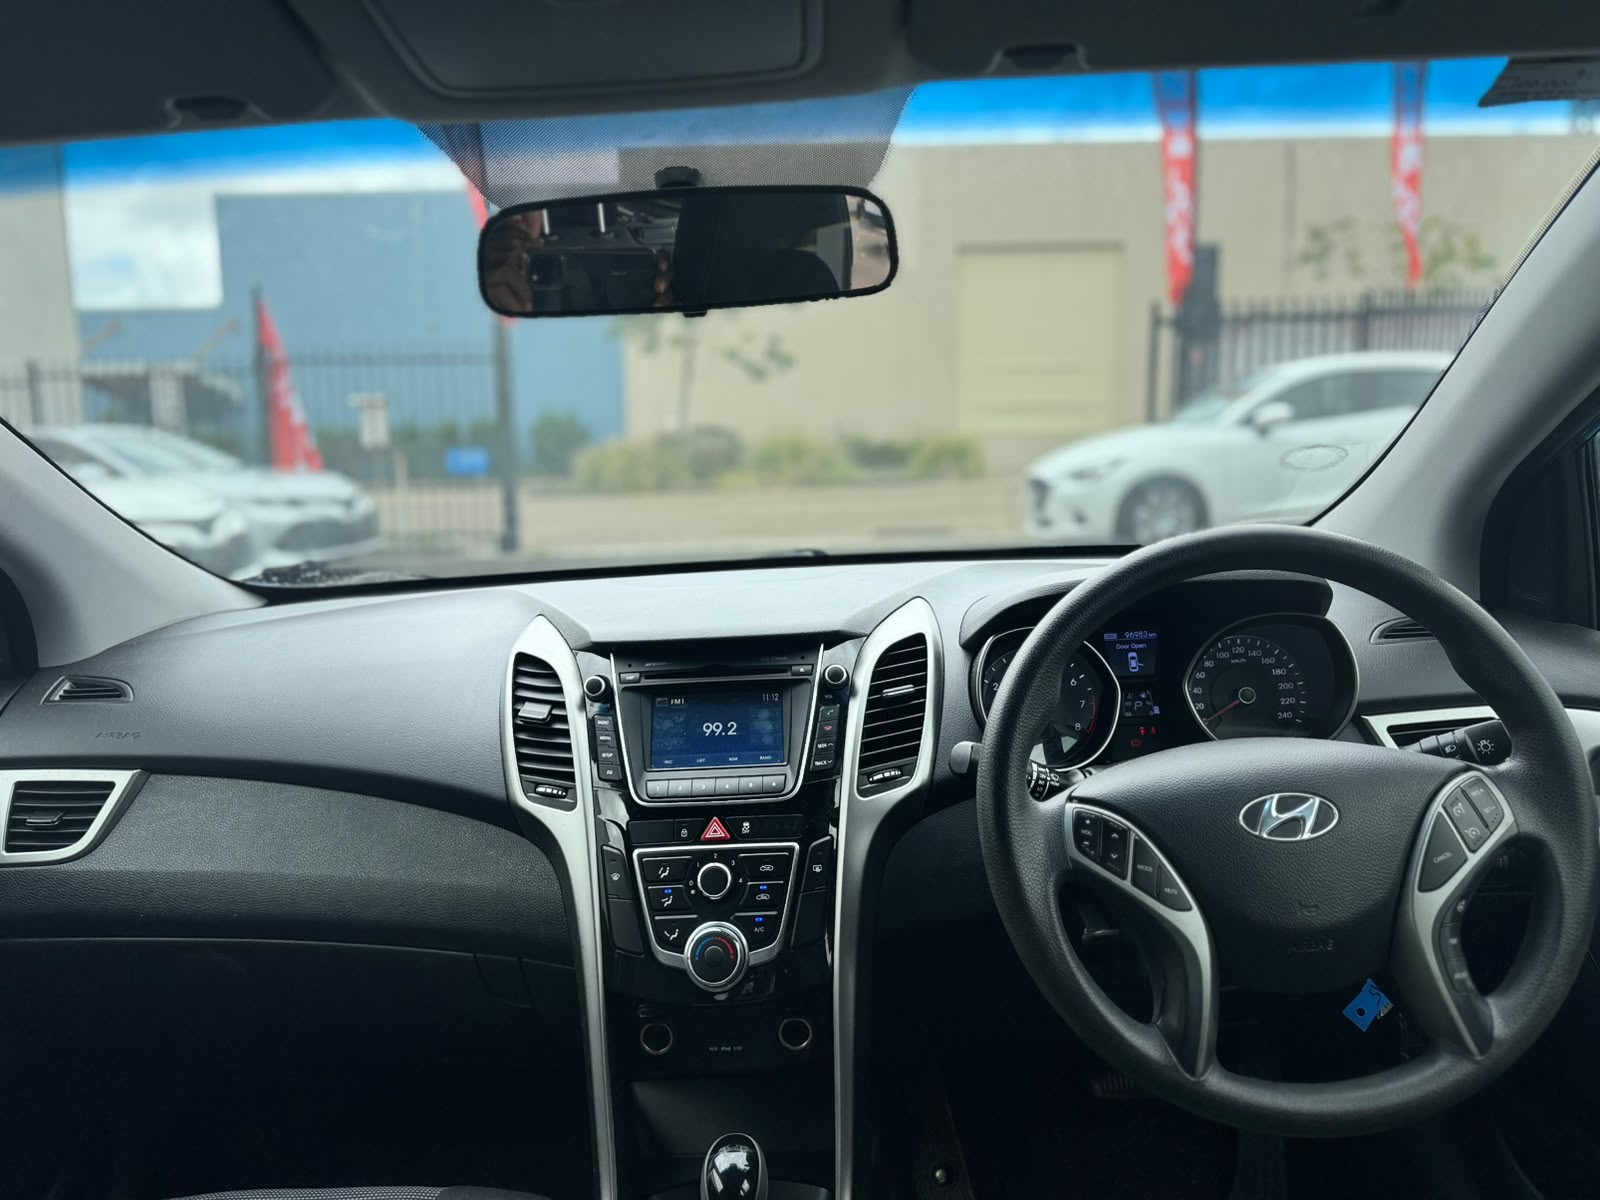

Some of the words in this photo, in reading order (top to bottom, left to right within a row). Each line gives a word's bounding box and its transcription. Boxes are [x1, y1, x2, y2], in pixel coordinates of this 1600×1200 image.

[1216, 651, 1229, 659] 100
[1247, 649, 1262, 657] 140
[1203, 660, 1214, 668] 80
[1195, 671, 1206, 679] 60
[1271, 668, 1286, 676] 180
[1070, 678, 1077, 686] 6
[992, 682, 999, 691] 2
[762, 692, 779, 702] 11:12
[1079, 700, 1085, 708] 7
[1194, 702, 1204, 710] 20
[1277, 711, 1293, 719] 240
[702, 721, 737, 736] 99.2
[1075, 722, 1081, 731] 8
[1137, 864, 1153, 873] MODE
